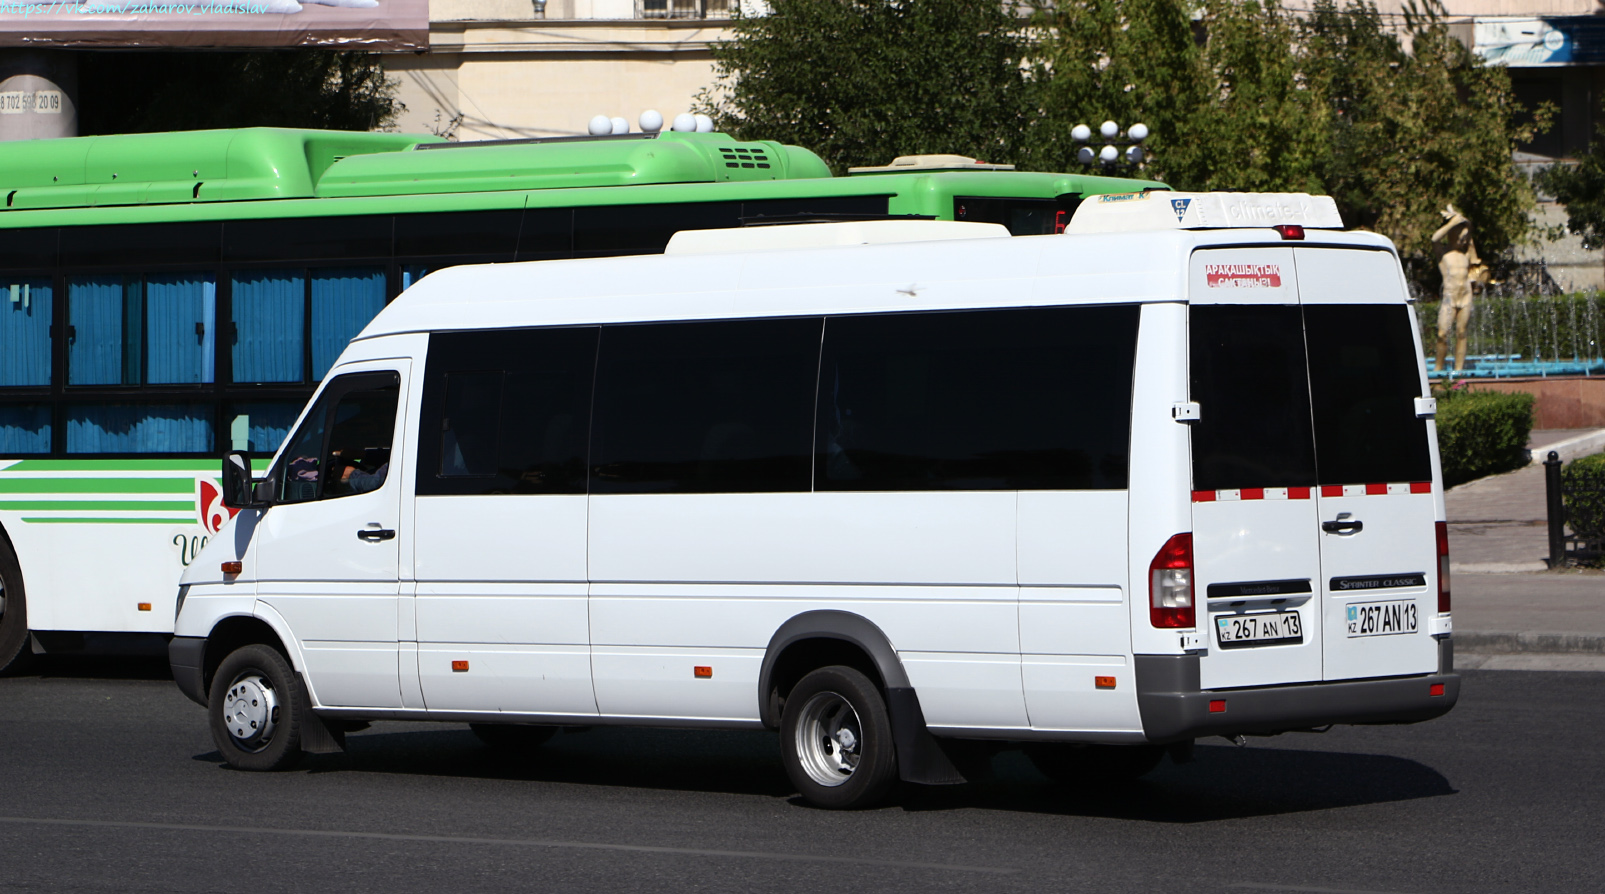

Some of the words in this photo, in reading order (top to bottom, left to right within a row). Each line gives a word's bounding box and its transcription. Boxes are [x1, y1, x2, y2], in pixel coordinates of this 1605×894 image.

[7, 95, 20, 109] 702
[39, 95, 48, 109] 20
[50, 95, 59, 109] 09
[1175, 200, 1187, 209] CL
[1176, 209, 1185, 217] 12
[1347, 622, 1357, 634] KZ
[1404, 603, 1417, 631] 13
[1221, 631, 1231, 641] KZ
[1233, 618, 1257, 639] 267
[1263, 621, 1279, 637] AN
[1283, 615, 1299, 636] 13
